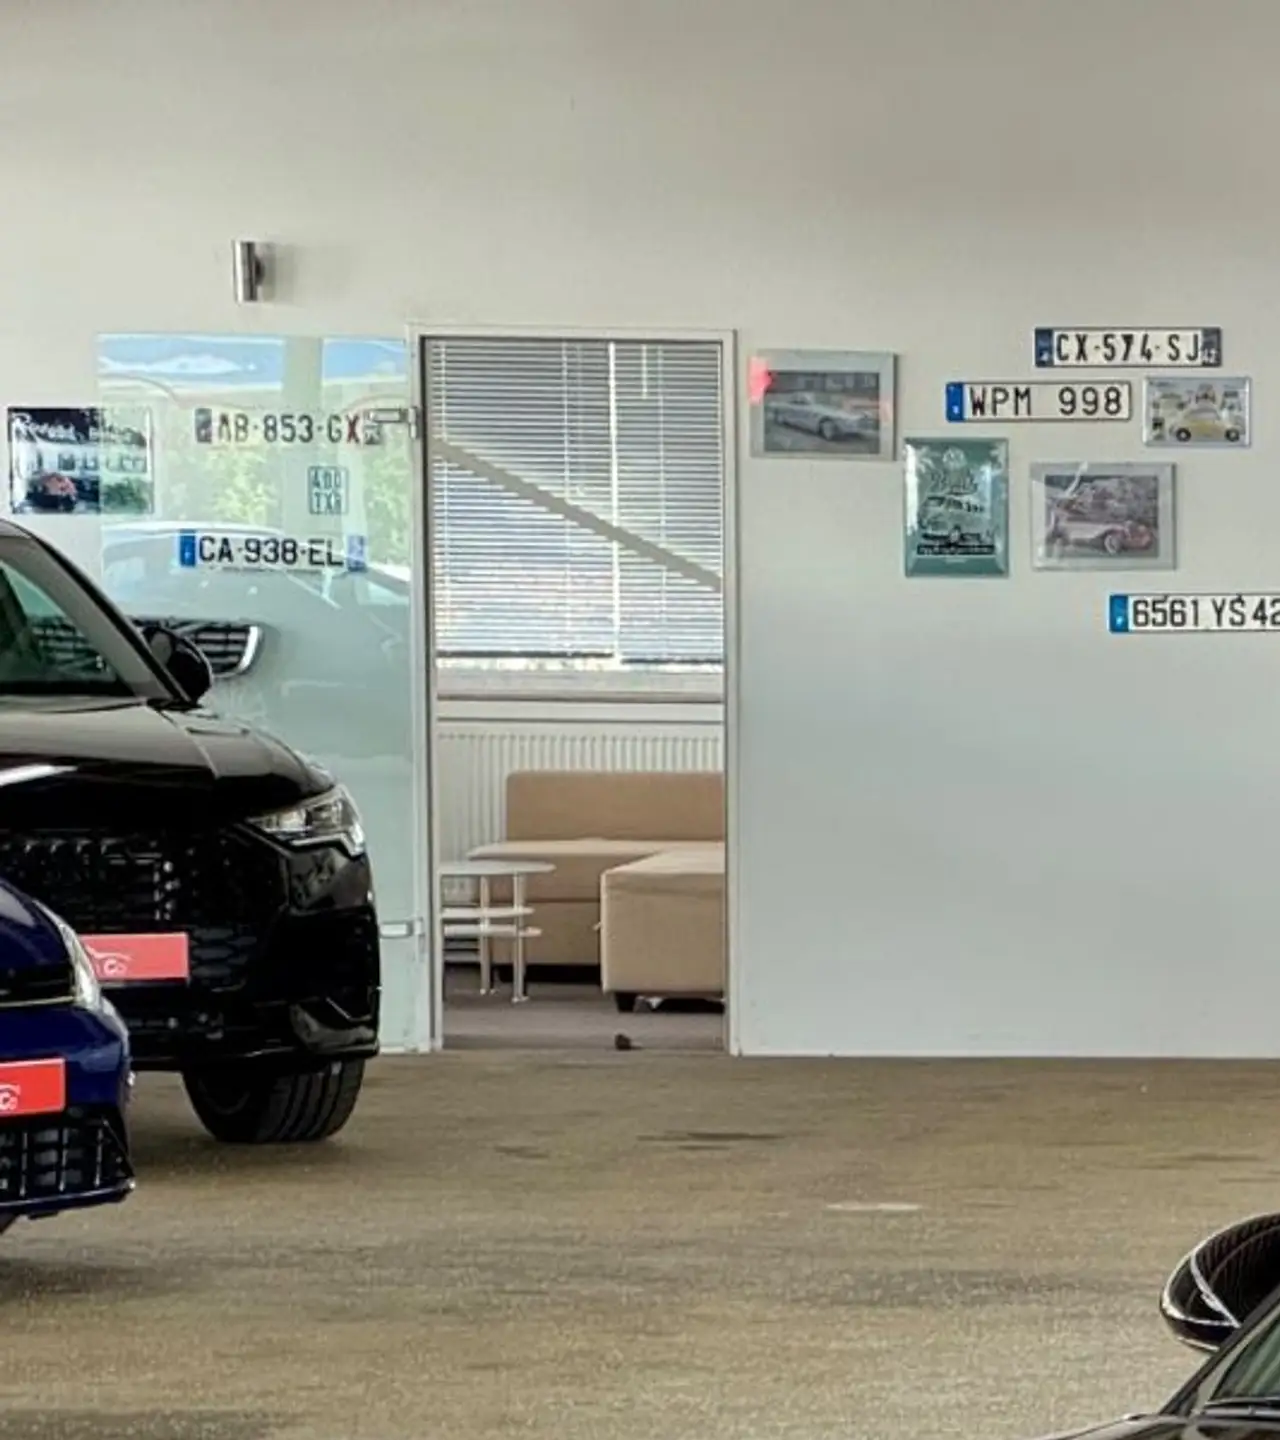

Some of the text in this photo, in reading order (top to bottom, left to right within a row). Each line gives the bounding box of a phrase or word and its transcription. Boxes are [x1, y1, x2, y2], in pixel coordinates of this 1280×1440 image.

[1056, 333, 1199, 362] CX-574-SJ
[970, 386, 1121, 416] WPM 998
[218, 413, 361, 443] AB-853-GX
[199, 536, 344, 566] CA-938-EL
[1133, 598, 1199, 627] 6561
[1211, 598, 1246, 627] YS
